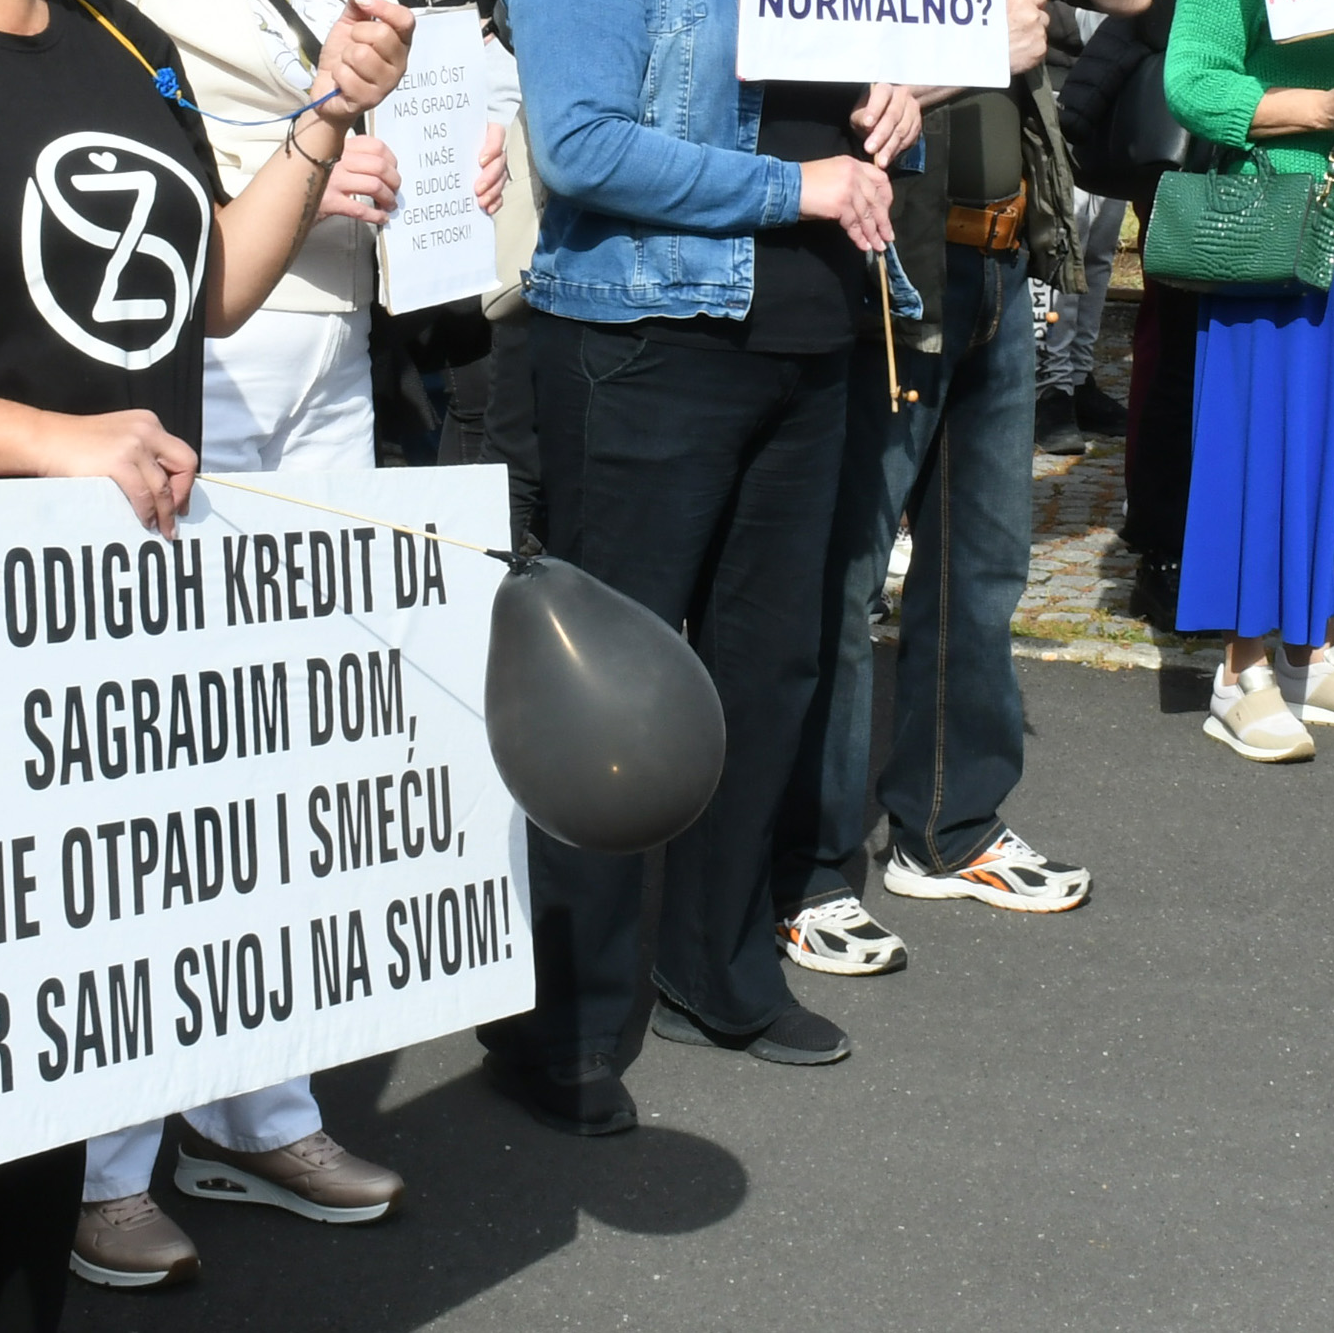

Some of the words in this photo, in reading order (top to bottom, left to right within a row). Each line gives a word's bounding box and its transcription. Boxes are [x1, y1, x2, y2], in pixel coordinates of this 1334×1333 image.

[440, 65, 465, 85] ČIST
[394, 97, 419, 119] NAŠ
[421, 94, 454, 114] GRAD
[456, 92, 470, 109] ZA
[423, 122, 448, 141] NAS
[418, 152, 423, 168] I
[425, 146, 455, 168] NAŠE
[403, 196, 475, 226] GENERACIJE!
[412, 233, 428, 251] NE
[430, 224, 472, 248] TROSKI!
[224, 525, 376, 624] KREDIT
[393, 522, 447, 609] DA
[23, 661, 290, 790] SAGRADIM
[307, 648, 418, 749] DOM,
[61, 798, 259, 929] OTPADU
[277, 792, 290, 885] I
[309, 748, 466, 878] SMEĆU,
[36, 957, 154, 1083] SAM
[175, 926, 294, 1047] SVOJ
[311, 909, 372, 1010] NA
[386, 875, 515, 990] SVOM!
